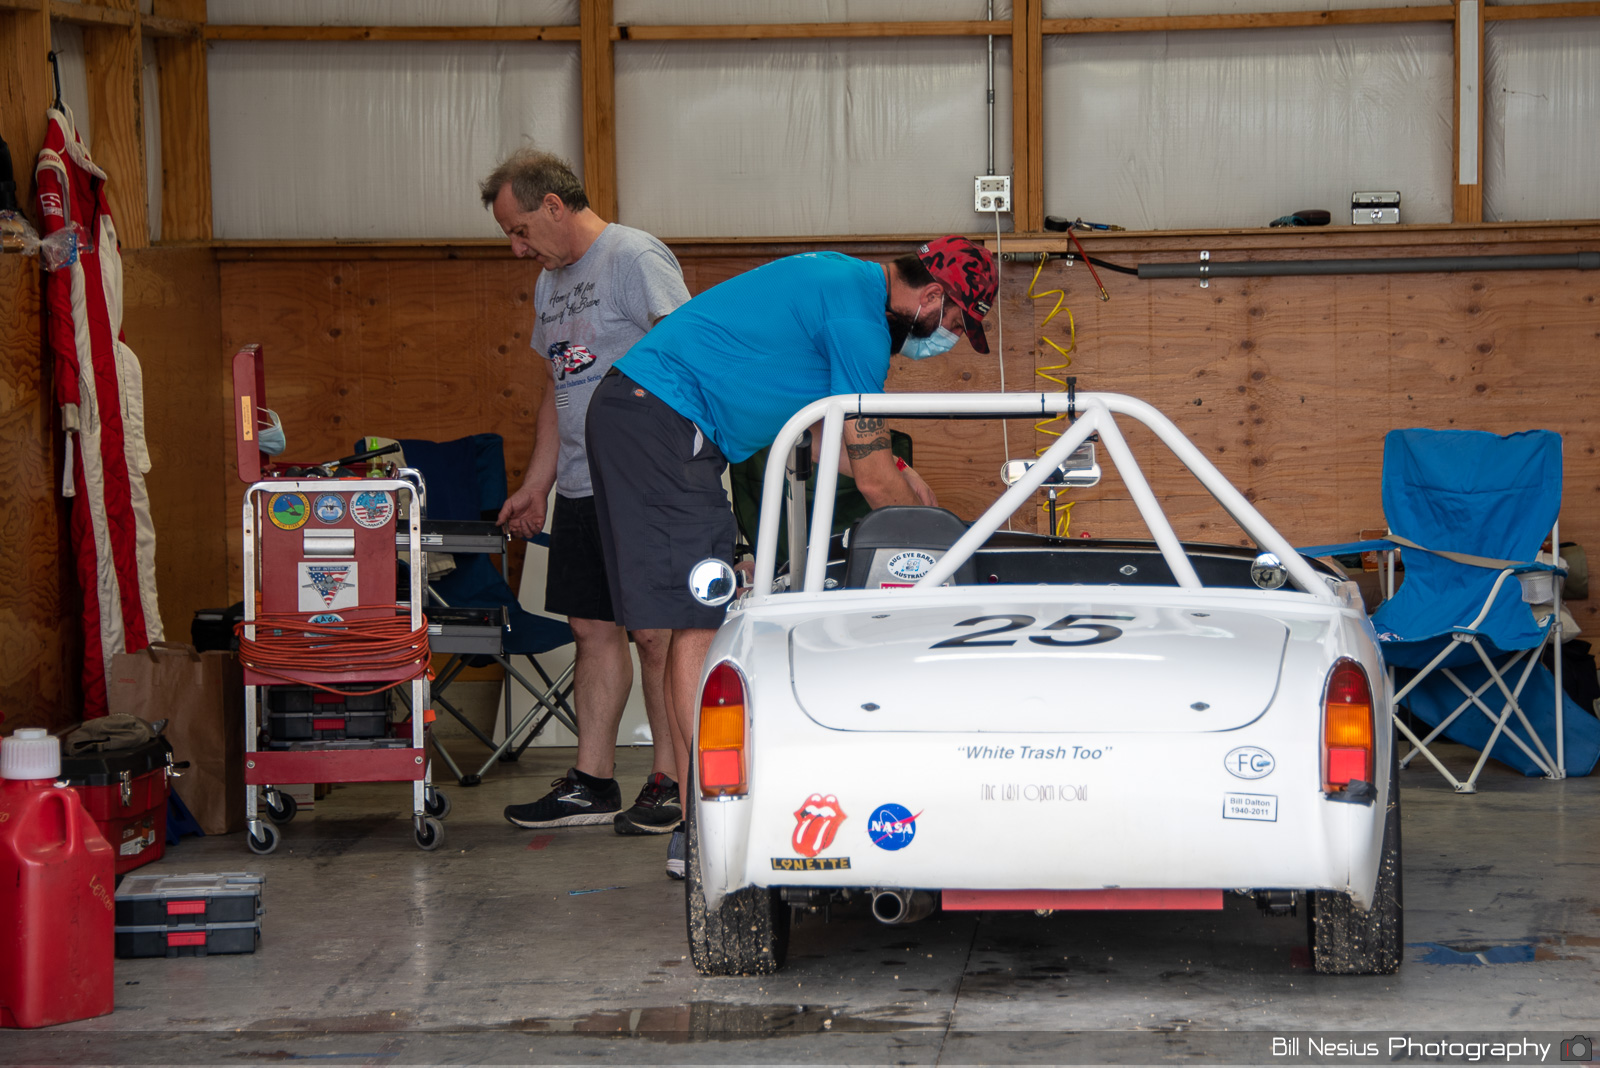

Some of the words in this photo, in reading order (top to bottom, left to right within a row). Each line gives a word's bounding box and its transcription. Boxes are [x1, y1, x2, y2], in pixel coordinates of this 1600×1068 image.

[889, 555, 902, 567] BUG
[916, 552, 934, 565] BARN
[928, 614, 1136, 649] 25
[1020, 746, 1066, 760] Trash
[1230, 797, 1243, 805] Bill
[1244, 798, 1270, 807] Dalton
[1231, 806, 1269, 816] 1940-2011
[871, 820, 913, 835] NASA
